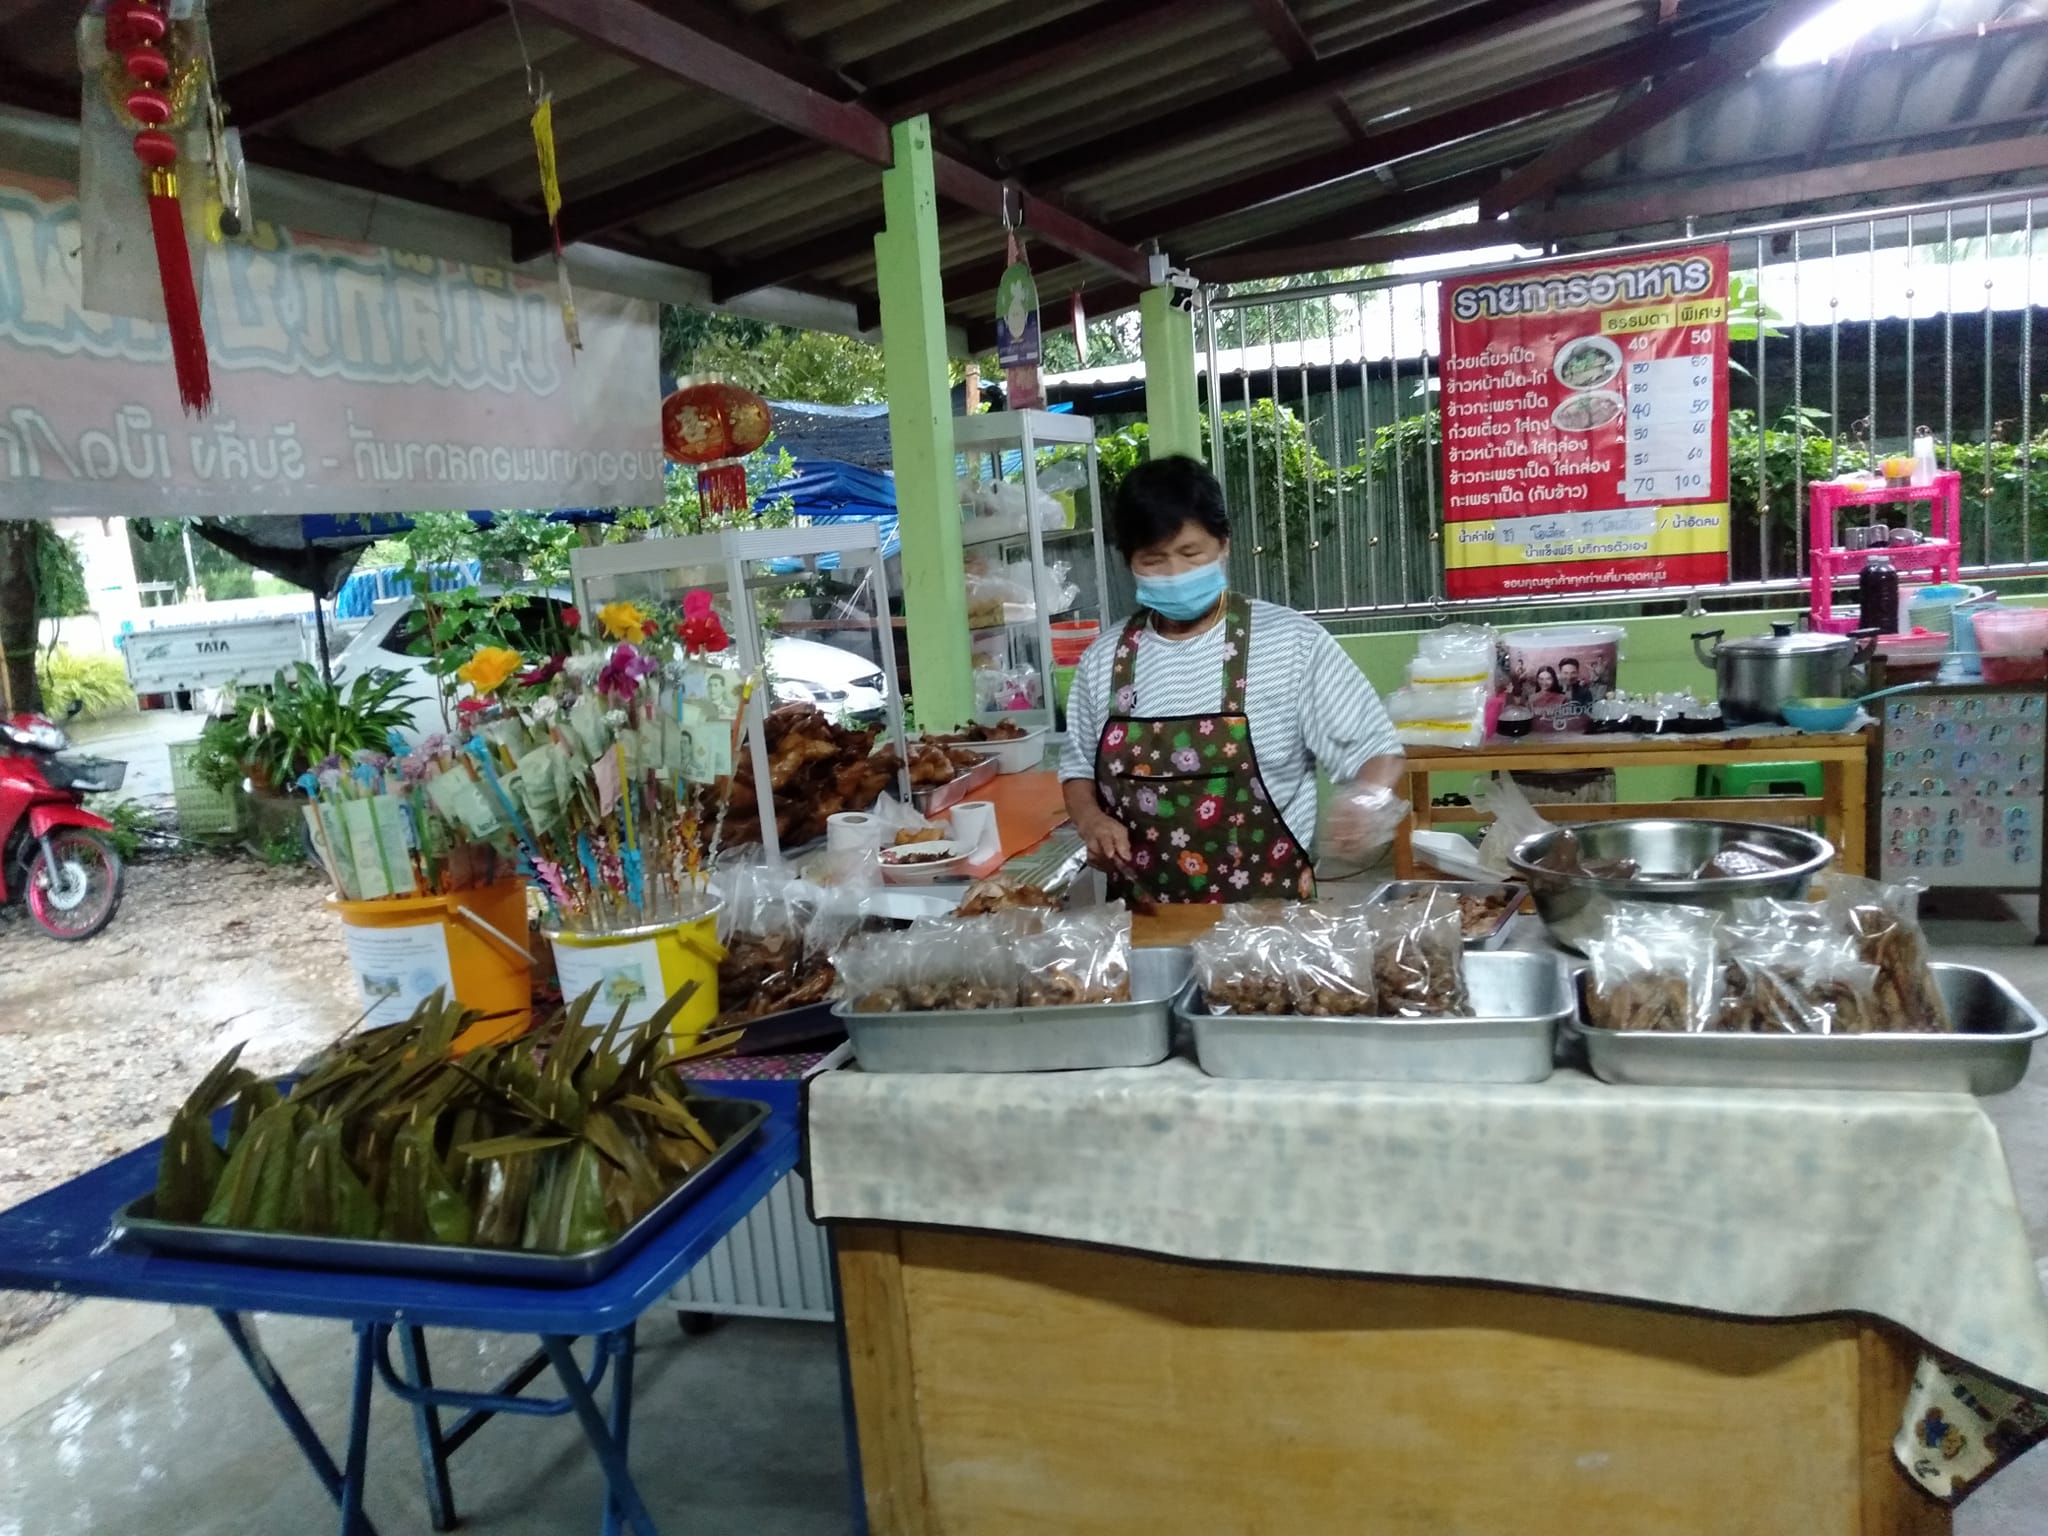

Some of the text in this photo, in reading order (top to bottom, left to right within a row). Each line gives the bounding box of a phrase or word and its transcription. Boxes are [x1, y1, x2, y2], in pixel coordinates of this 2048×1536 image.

[1453, 258, 1711, 321] รายการอาหาร
[1608, 304, 1722, 330] ธรรมดา พิเศษ
[1628, 329, 1712, 351] 40 50
[1446, 345, 1535, 372] ก๋วยเตี๋ยวเป็ด
[1447, 394, 1548, 417] ข้าวกะเพราเป็ด
[1632, 403, 1651, 419] 40
[1448, 441, 1527, 463] ข้าวหน้าเป็ด
[1449, 456, 1610, 485] ข้าวกะเพราเป็ด ใส่กล่อง
[1634, 474, 1701, 494] 70 100
[1450, 483, 1588, 508] กะเพราเป็ด (กับข้าว)
[1672, 514, 1720, 529] น้ำอัดลม
[1577, 540, 1648, 555] บริการตัวเอง
[195, 639, 230, 653] TATA
